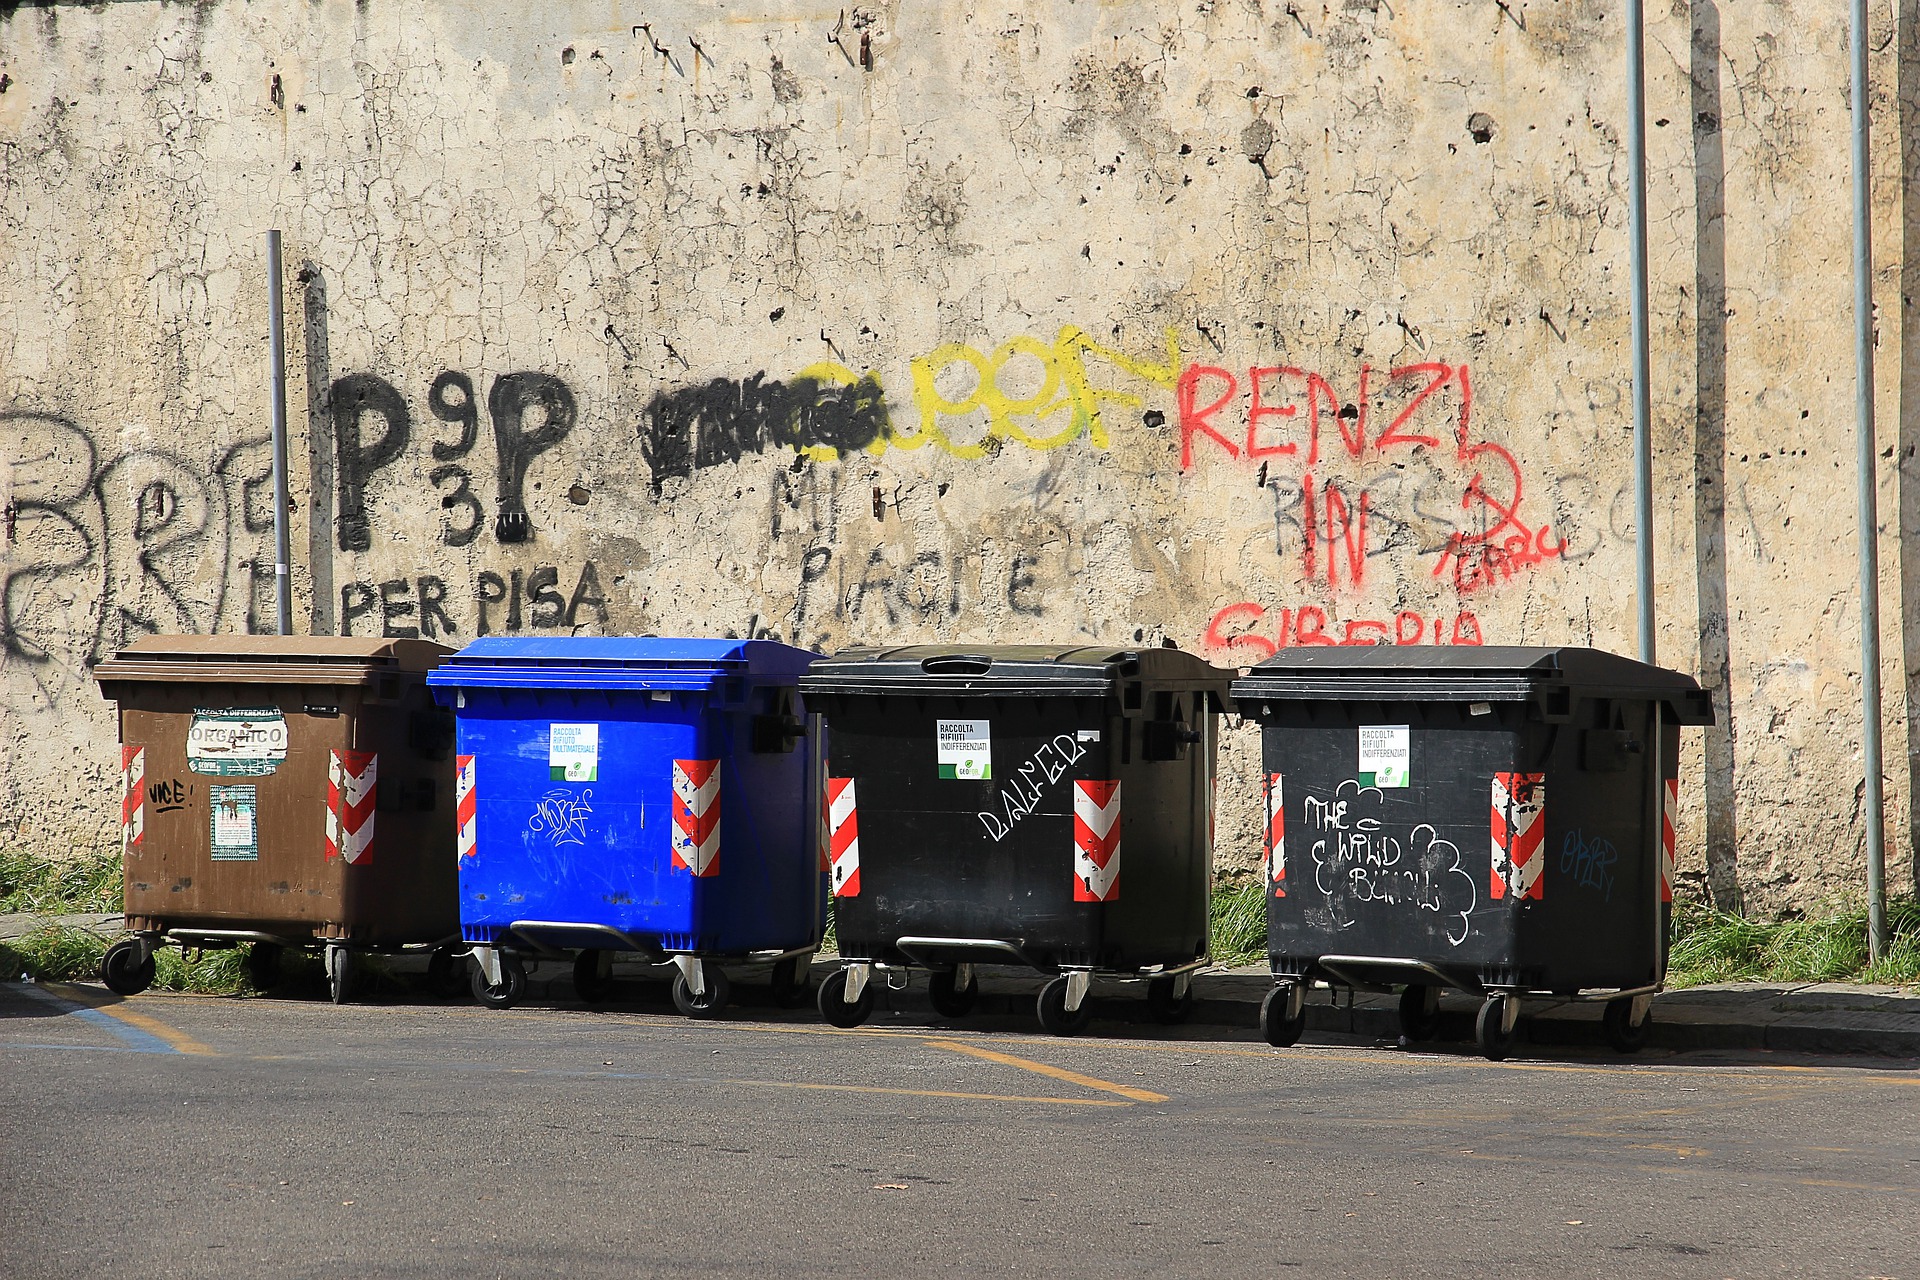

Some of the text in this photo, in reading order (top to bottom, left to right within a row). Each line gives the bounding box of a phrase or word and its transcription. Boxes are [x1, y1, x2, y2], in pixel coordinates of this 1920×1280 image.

[1177, 363, 1472, 471] RENZI
[341, 560, 608, 638] PER PISA
[553, 727, 582, 736] RACCOLTA
[940, 724, 974, 733] RACCOLTA
[940, 733, 965, 742] RIFIUTI
[1362, 730, 1395, 739] RACCOLTA
[553, 736, 576, 745] RIFIUTO
[1362, 739, 1386, 749] RIFIUTI
[553, 745, 596, 753] MULTIMATERIALE
[940, 742, 987, 751] INDIFFERENZIATI
[1362, 749, 1407, 758] INDIFFERENZIATI
[1304, 796, 1350, 832] THE
